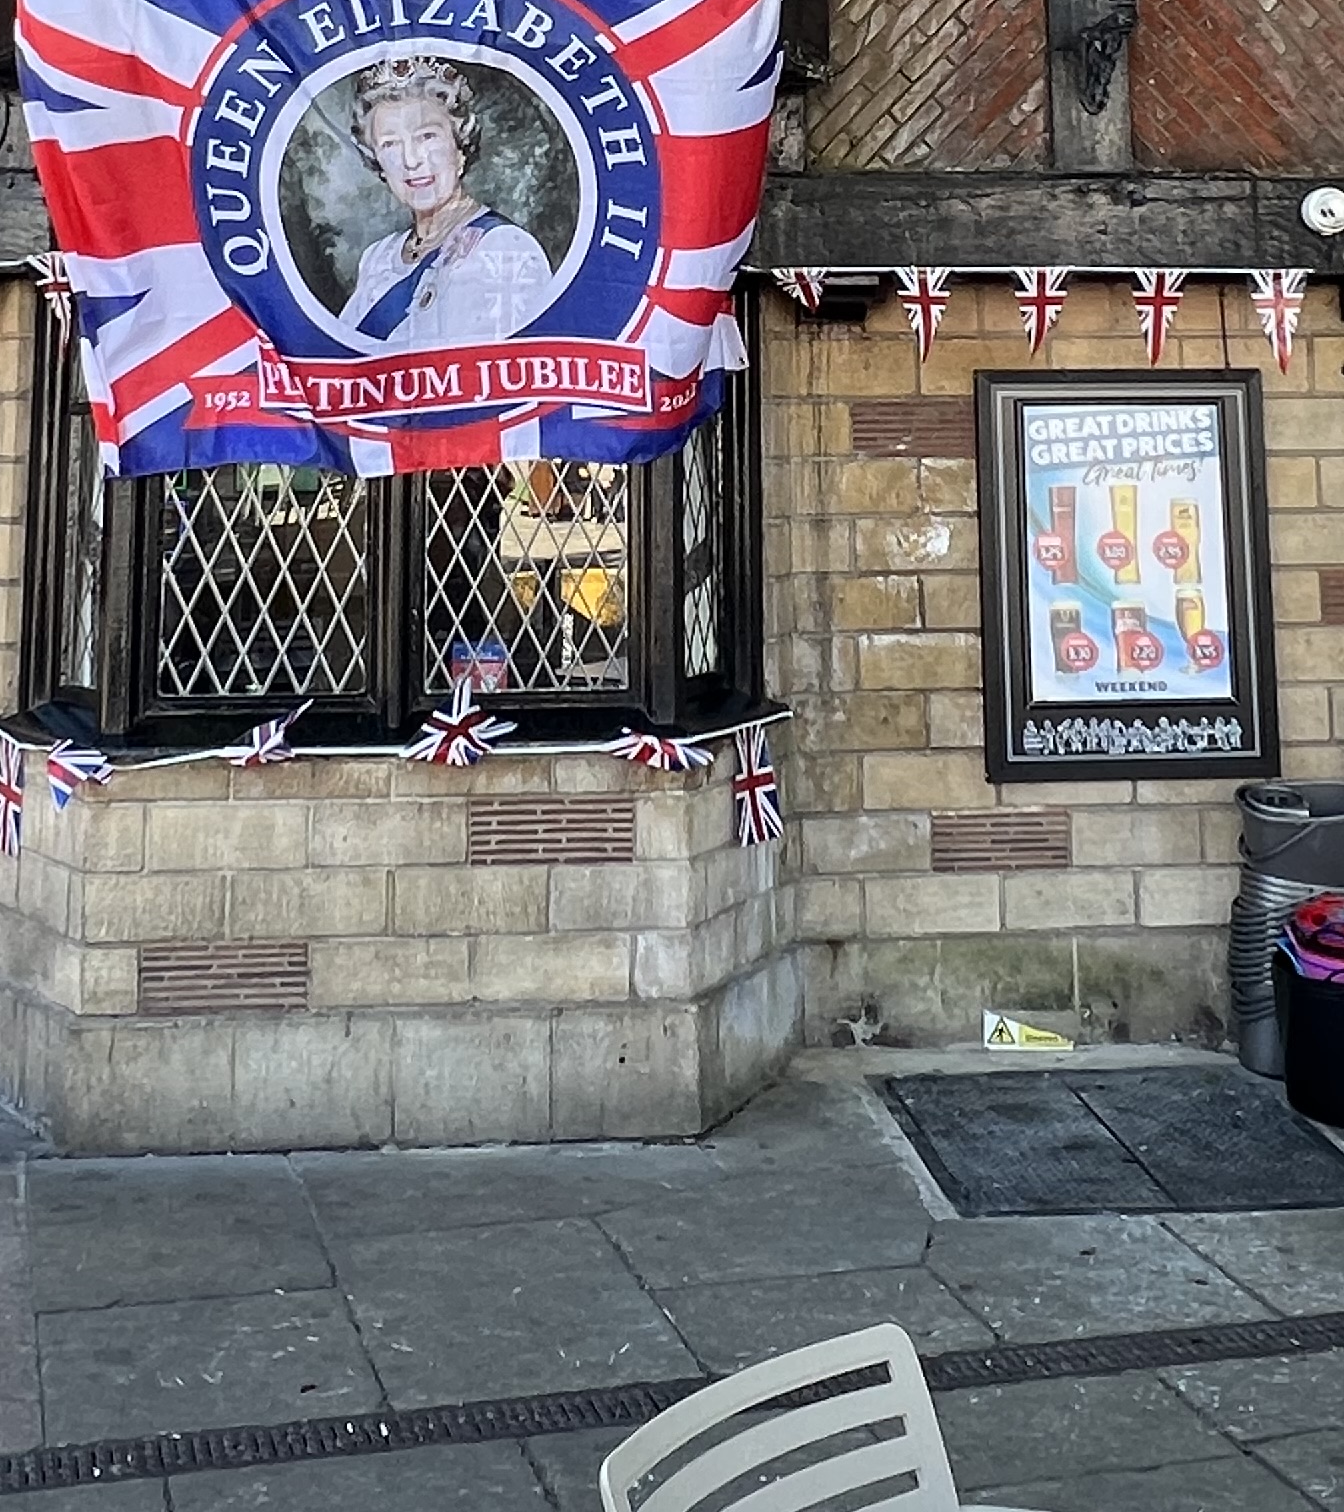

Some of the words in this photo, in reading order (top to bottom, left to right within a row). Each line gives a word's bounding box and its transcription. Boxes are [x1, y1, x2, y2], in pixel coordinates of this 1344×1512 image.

[206, 38, 296, 276] QUEEN
[600, 198, 647, 260] II
[474, 356, 644, 402] JUBILEE
[204, 390, 251, 412] 1952
[1029, 415, 1113, 441] GREAT
[1115, 408, 1212, 435] DRINKS
[1031, 438, 1117, 466] GREAT
[1121, 431, 1214, 458] PRICES
[1082, 458, 1145, 486] Great
[1094, 680, 1168, 693] WEEKEND
